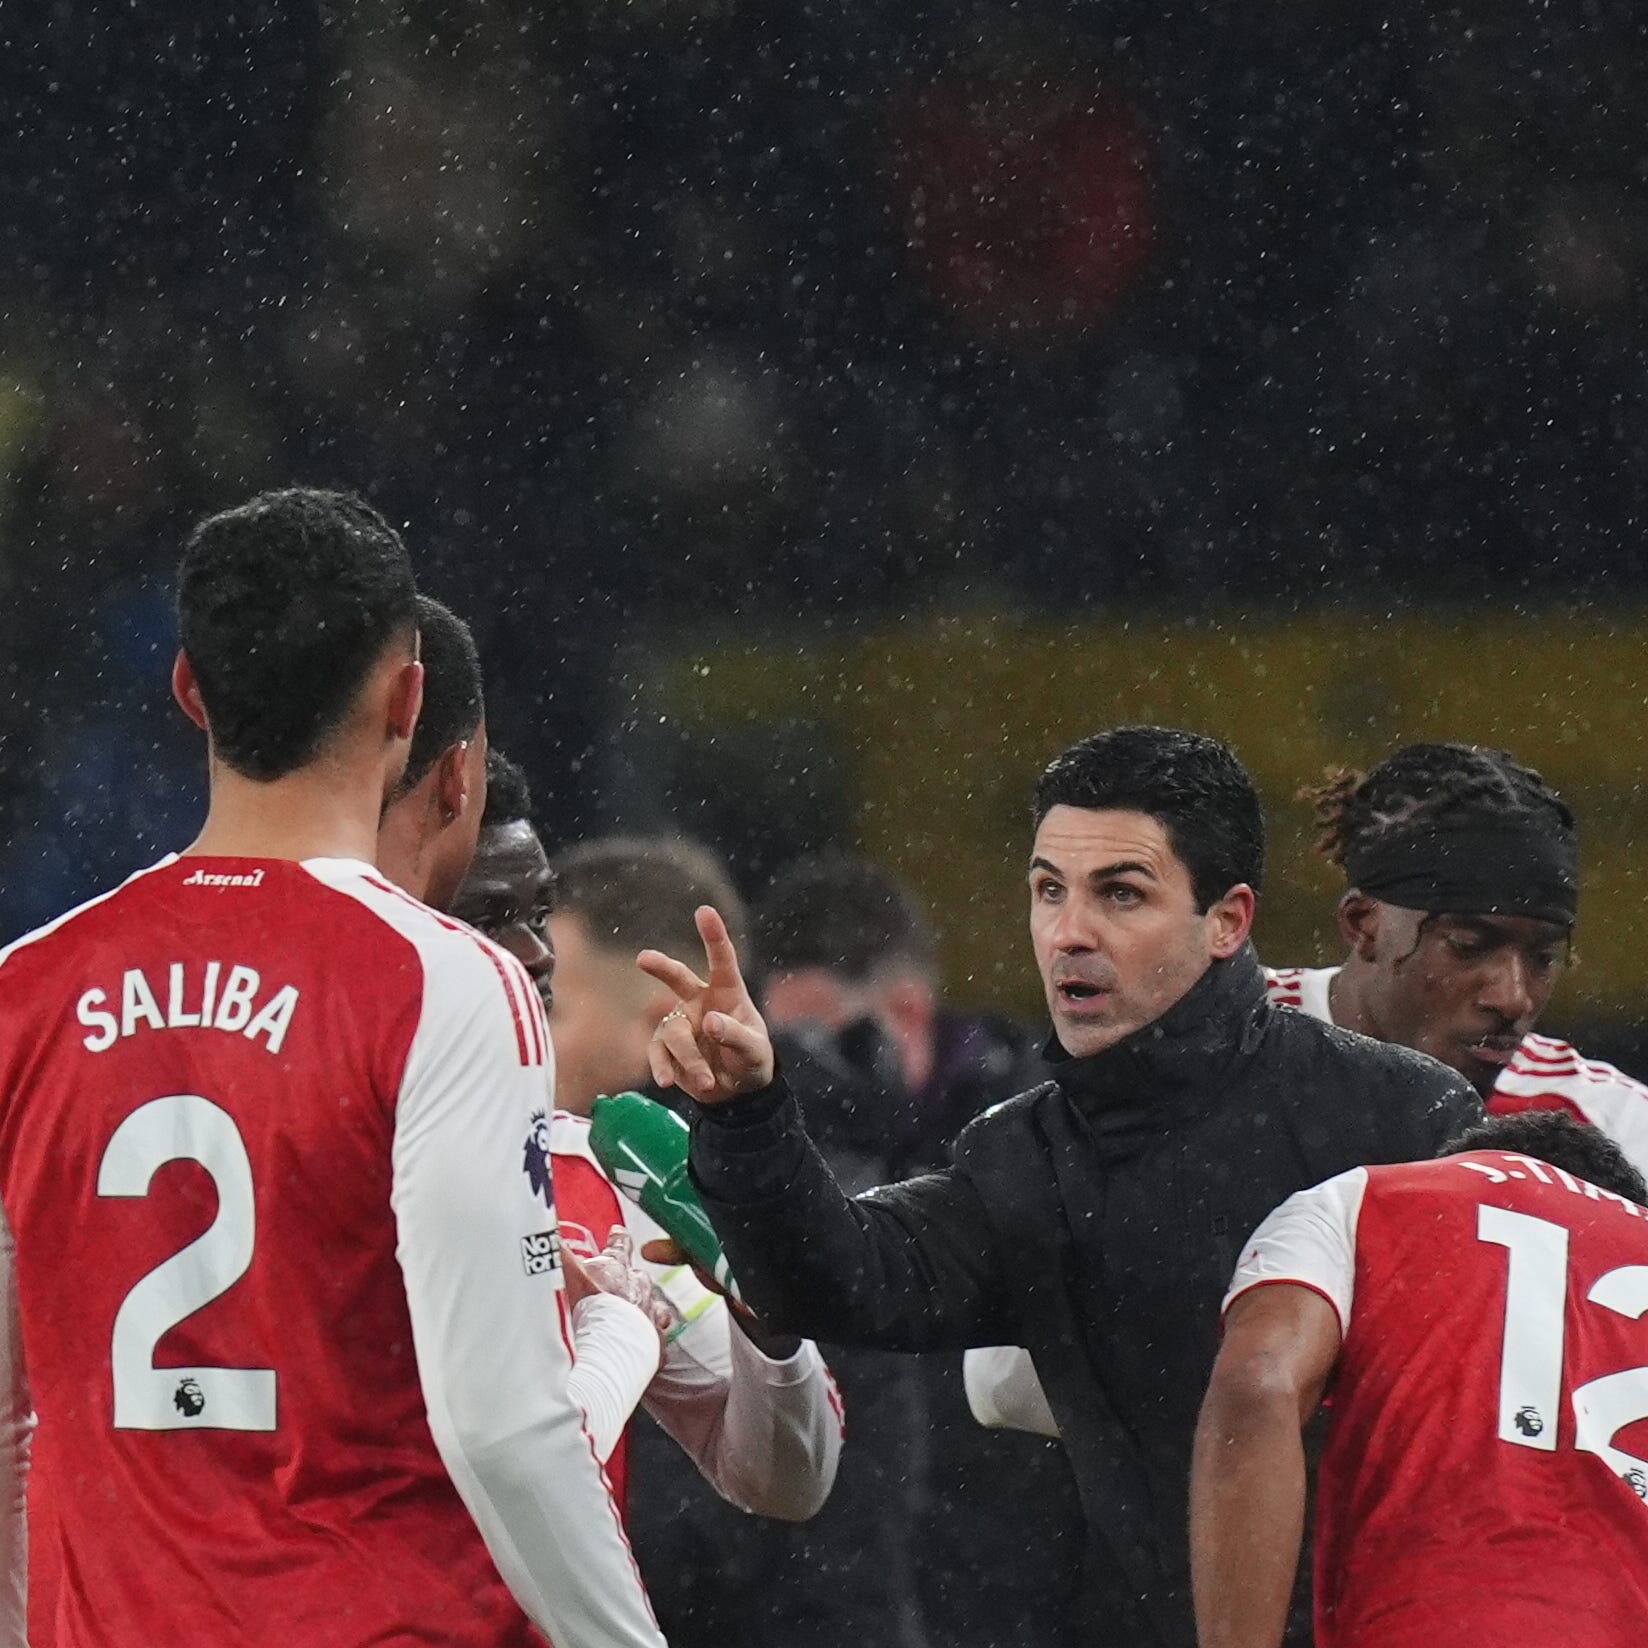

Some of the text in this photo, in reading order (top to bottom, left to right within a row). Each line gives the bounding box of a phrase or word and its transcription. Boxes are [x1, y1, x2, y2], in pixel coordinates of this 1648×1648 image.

[182, 868, 266, 888] Arsenal
[76, 961, 301, 1055] SALIBA
[95, 1093, 278, 1431] 2
